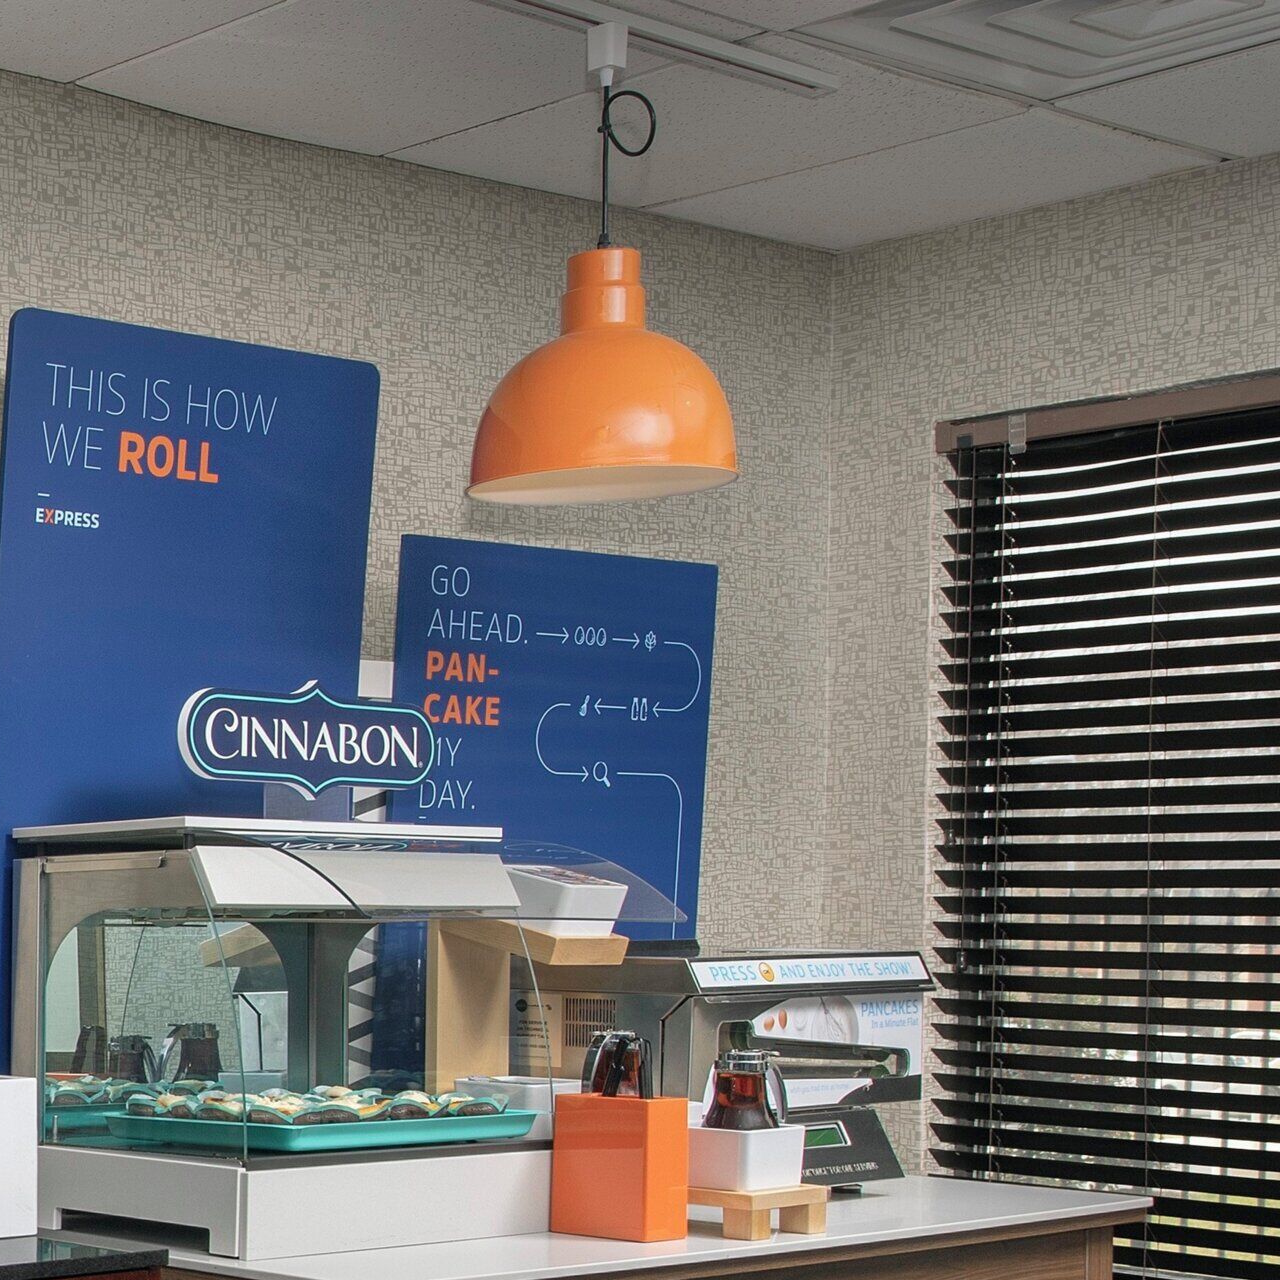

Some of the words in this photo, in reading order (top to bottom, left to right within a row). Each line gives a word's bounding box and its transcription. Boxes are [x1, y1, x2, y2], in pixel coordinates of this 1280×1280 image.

[46, 362, 127, 416] THIS
[142, 377, 171, 422] IS
[186, 383, 278, 436] HOW
[42, 420, 104, 470] WE
[118, 430, 219, 484] ROLL
[35, 507, 100, 529] EXPRESS
[431, 564, 471, 597] GO
[427, 608, 528, 645] AHEAD.
[425, 650, 500, 683] PAN-
[423, 693, 501, 726] CAKE
[205, 707, 419, 769] CINNABON
[418, 779, 476, 810] DAY.
[709, 965, 757, 982] PRESS
[779, 964, 805, 979] AND
[809, 963, 846, 978] ENJOY
[848, 962, 871, 977] THE
[877, 961, 914, 975] SHOW!
[861, 1000, 919, 1016] PANCAKES
